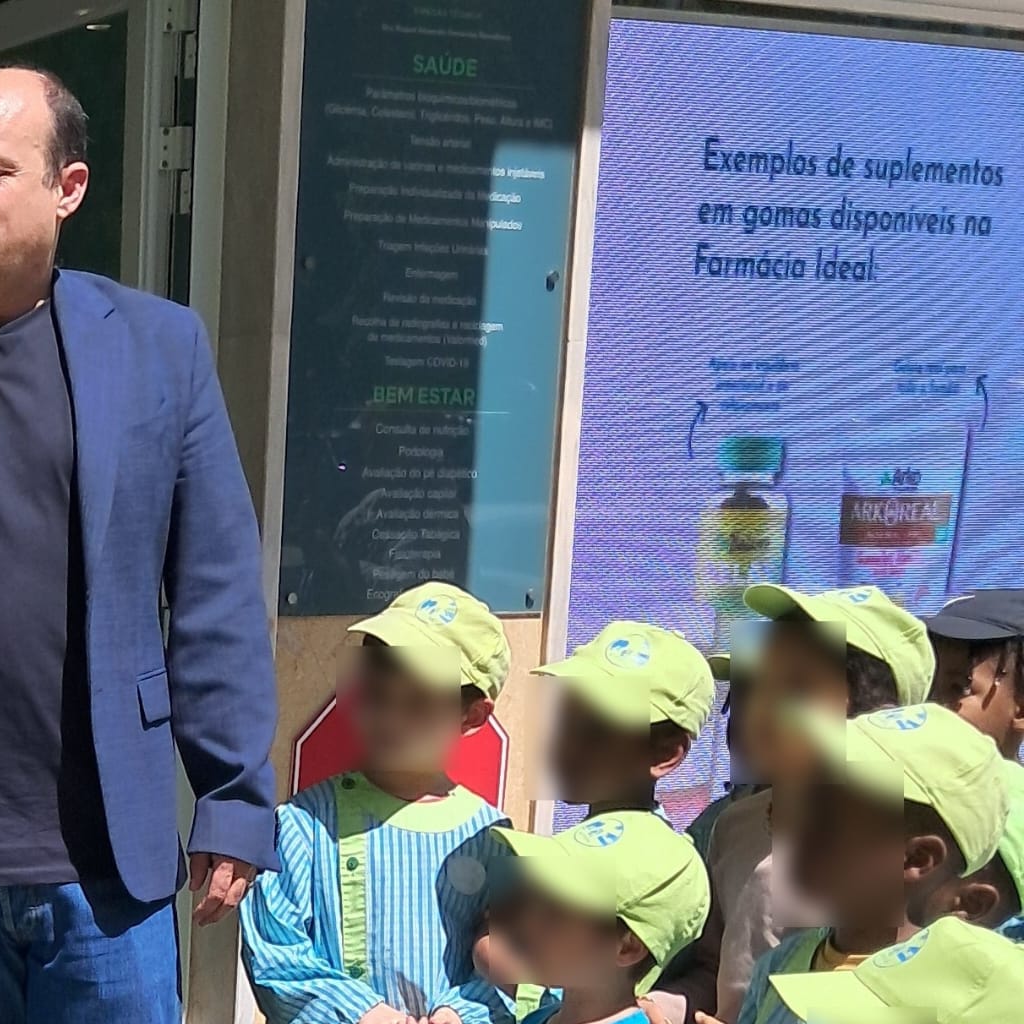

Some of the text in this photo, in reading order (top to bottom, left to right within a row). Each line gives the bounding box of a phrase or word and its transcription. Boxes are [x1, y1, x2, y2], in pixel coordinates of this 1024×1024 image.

[412, 50, 479, 78] SAÚDE
[703, 137, 1004, 188] Exemplos de suplementos
[697, 197, 992, 240] em gomas disponíveis na
[694, 242, 807, 278] Farmácia
[372, 386, 477, 407] BEM ESTAR
[398, 445, 444, 461] Podologia
